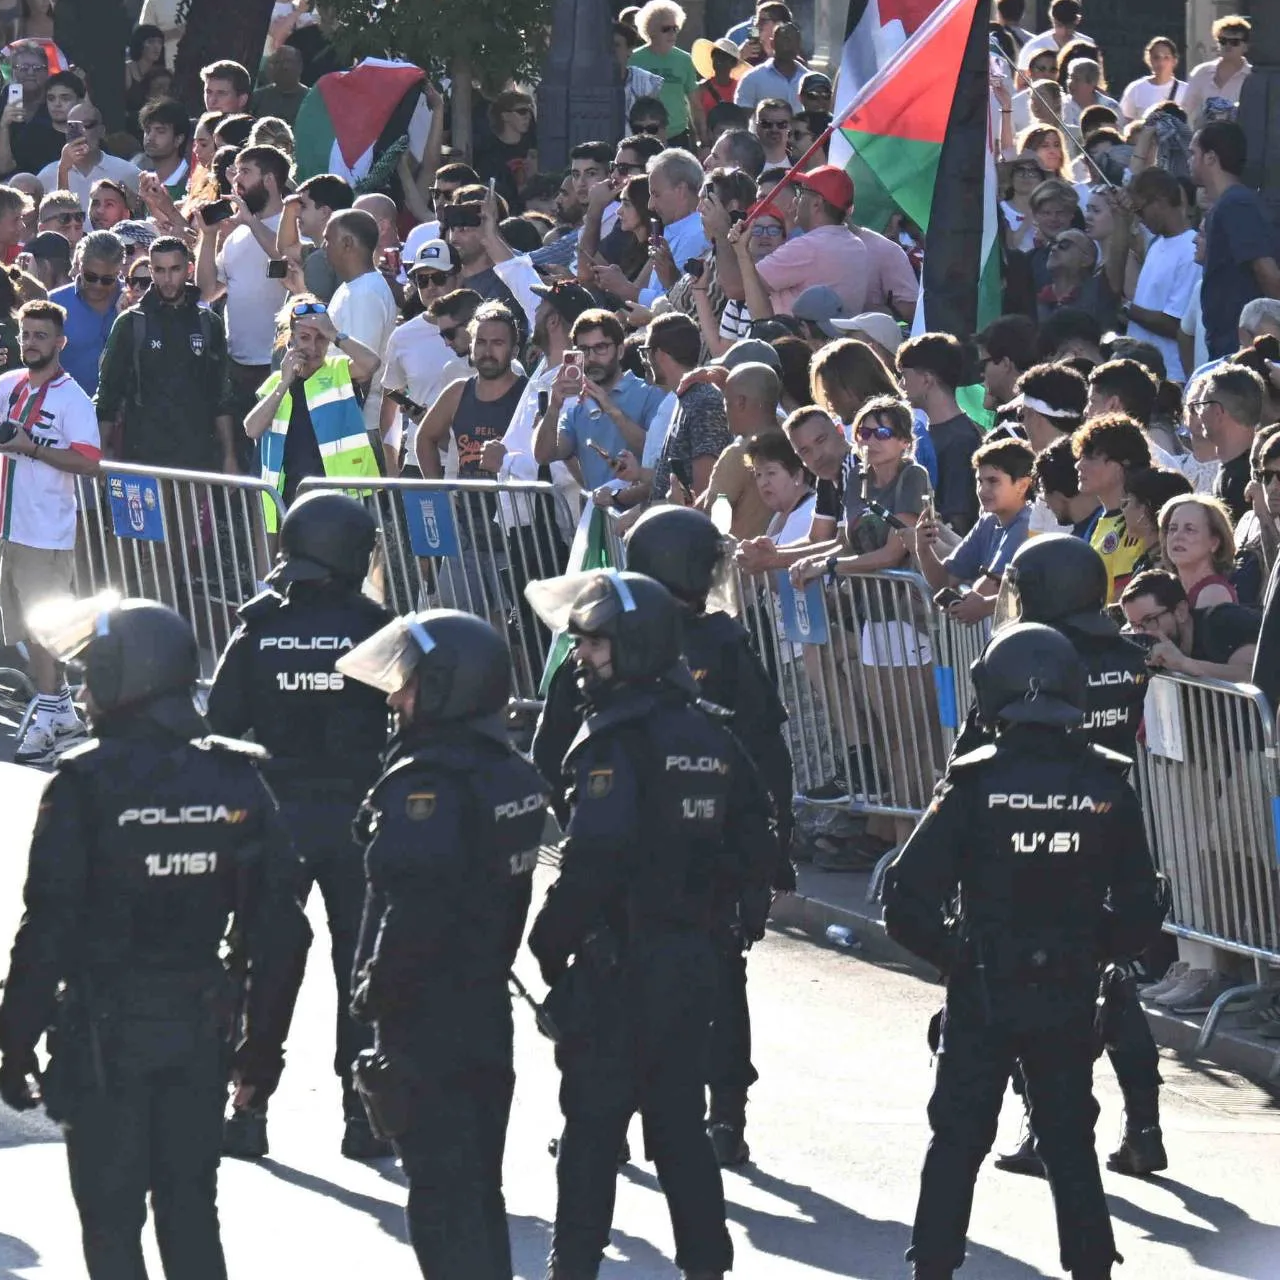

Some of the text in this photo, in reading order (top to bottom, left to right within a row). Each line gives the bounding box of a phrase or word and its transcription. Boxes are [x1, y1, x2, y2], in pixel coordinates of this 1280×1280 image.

[260, 636, 354, 651] POLICIA
[276, 672, 344, 691] 1U1196
[988, 794, 1096, 812] POLICIA
[118, 804, 229, 827] POLICIA
